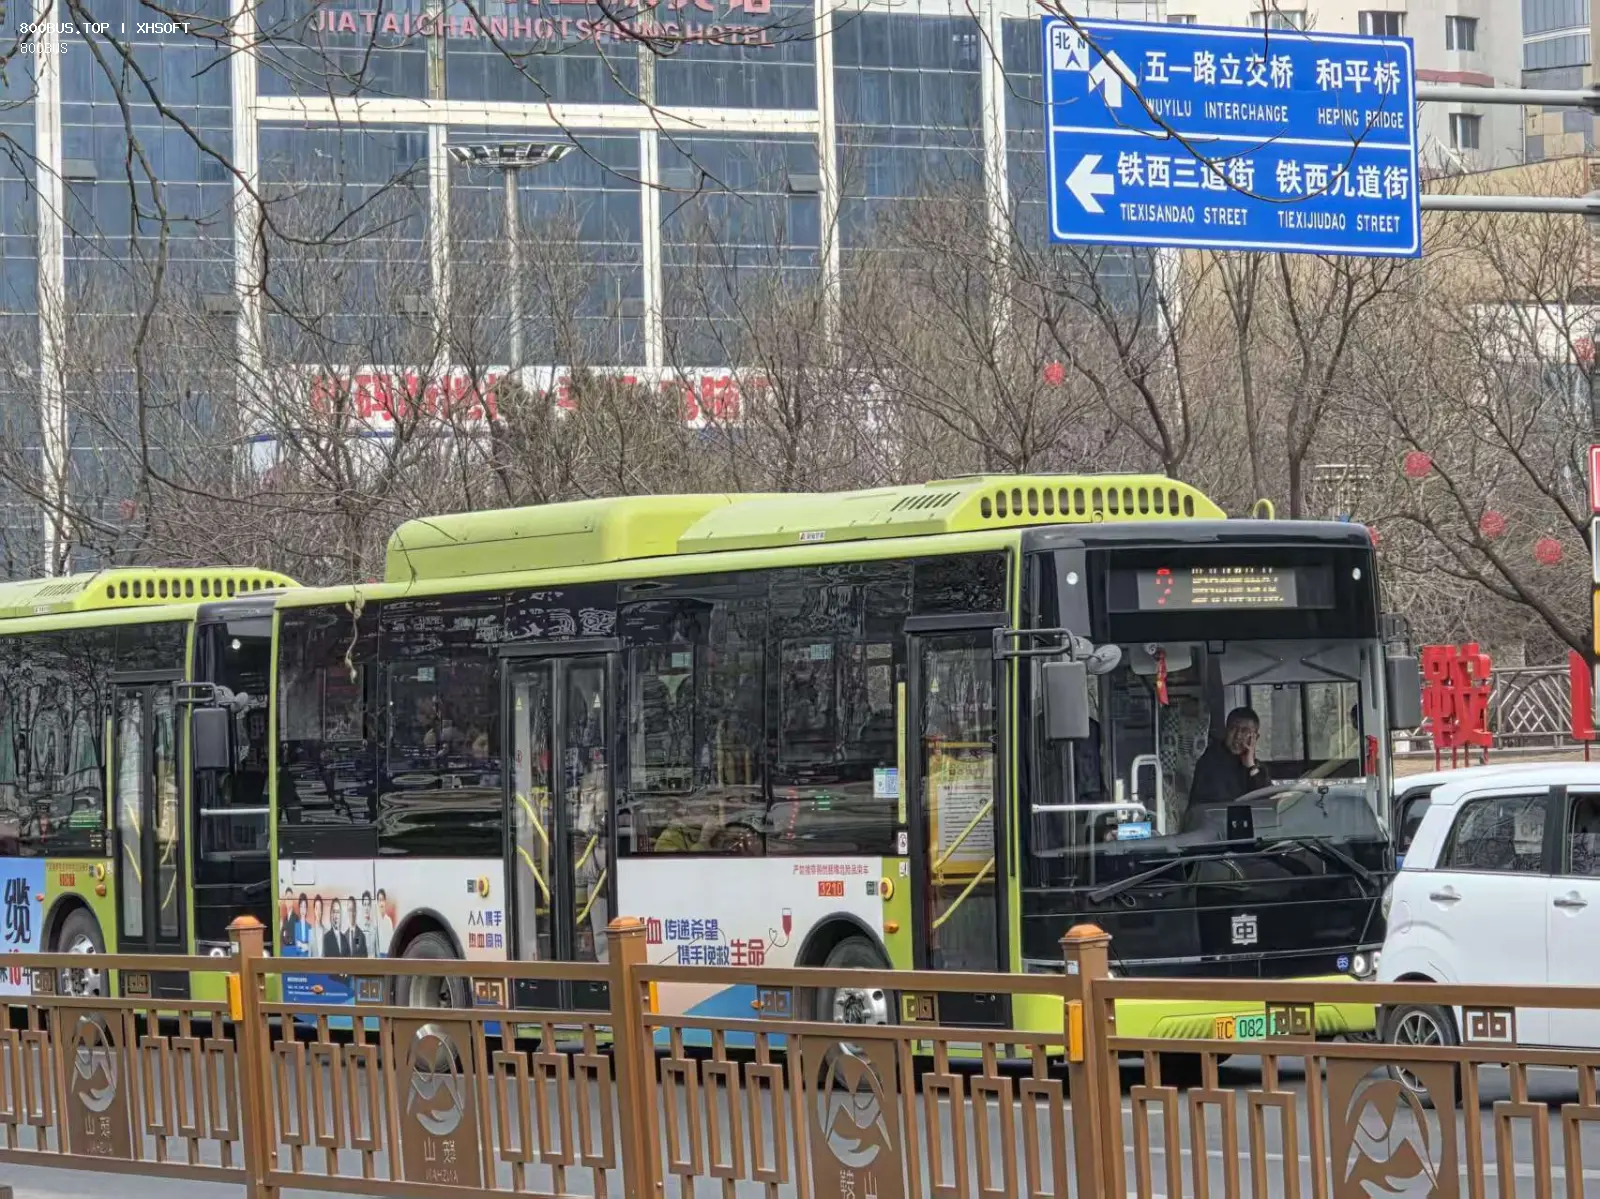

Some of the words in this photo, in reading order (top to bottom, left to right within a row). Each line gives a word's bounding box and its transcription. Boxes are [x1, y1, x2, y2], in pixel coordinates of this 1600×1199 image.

[1054, 31, 1070, 51] 北
[1076, 38, 1087, 50] N
[1144, 50, 1295, 90] 五一路立交桥
[1316, 58, 1402, 95] 和平桥
[1145, 98, 1193, 118] WUYILU
[1204, 101, 1290, 123] INTERCHANGE
[1317, 108, 1360, 128] HEPING
[1365, 112, 1404, 130] BRIDGE
[1117, 151, 1256, 194] 铁西三道街
[1276, 160, 1409, 201] 铁西九道街
[1120, 203, 1195, 224] TIEXISANDAO
[1204, 207, 1248, 227] STREET
[1277, 210, 1346, 232] TIEXIJIUDAO
[1356, 214, 1401, 234] STREET
[820, 882, 843, 896] 3210
[639, 917, 719, 946] 血传递希望
